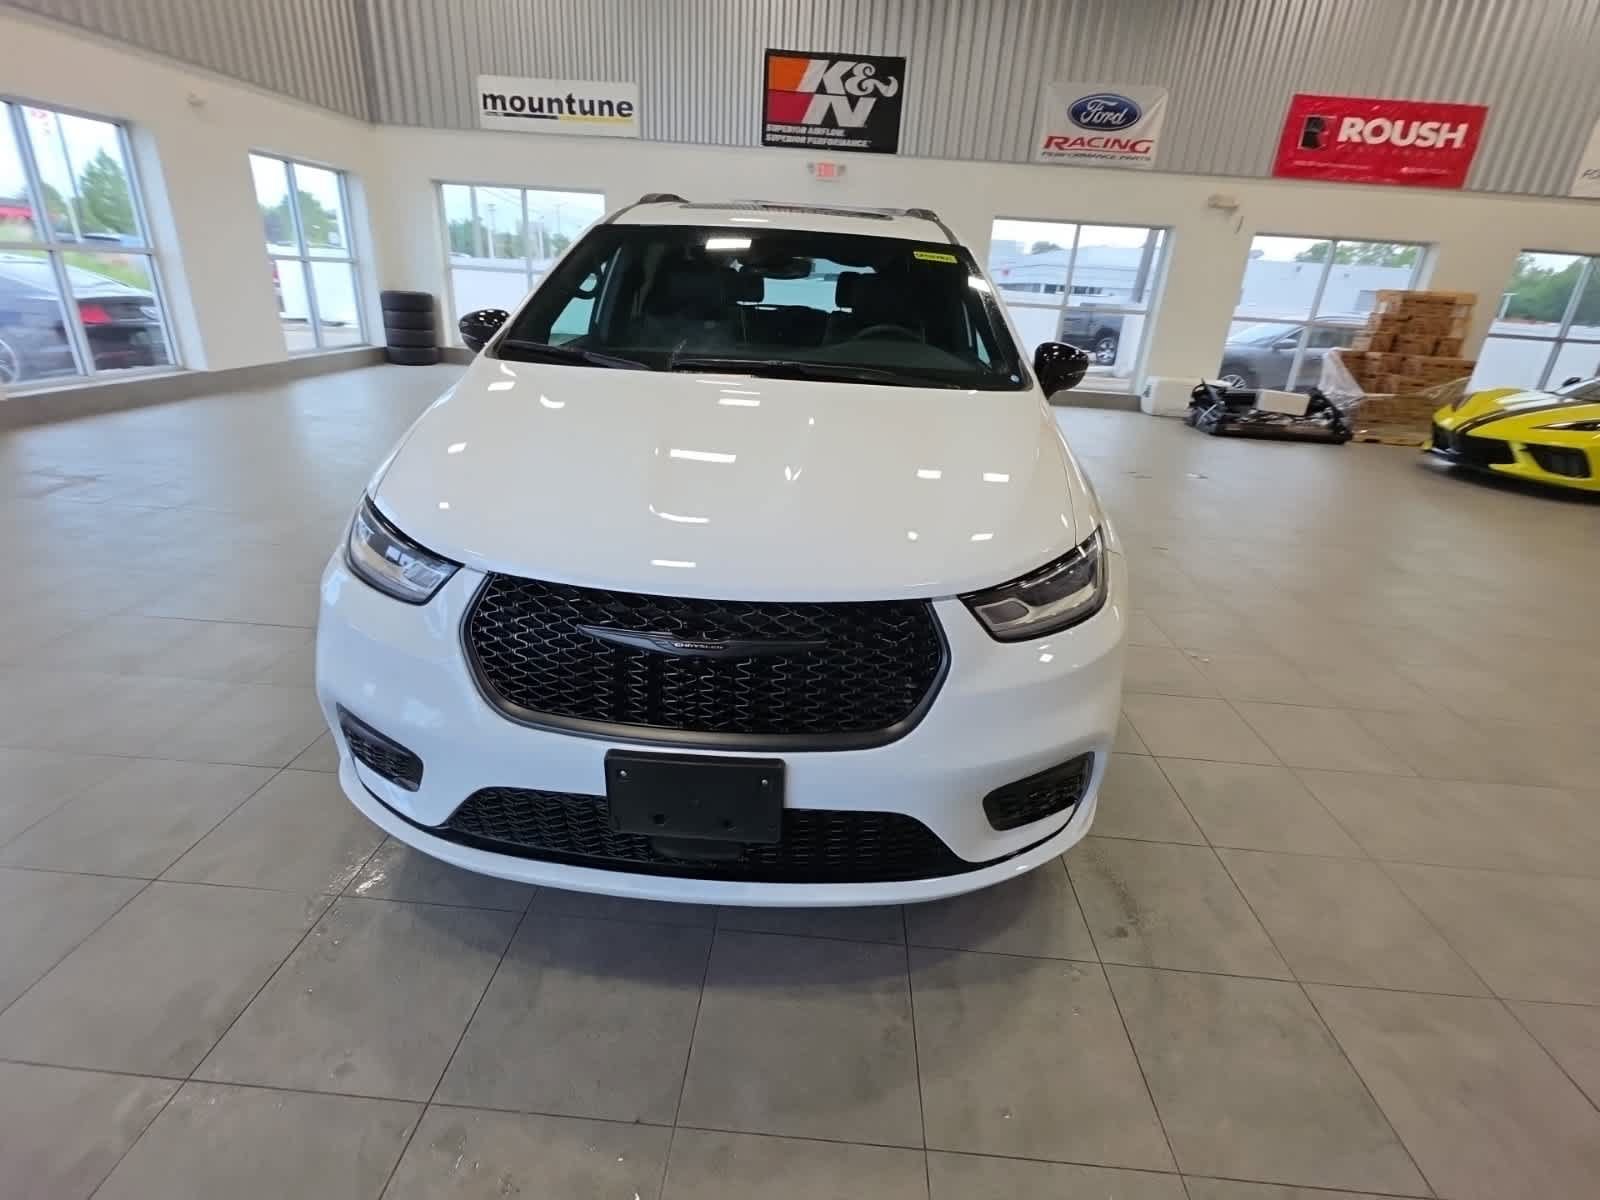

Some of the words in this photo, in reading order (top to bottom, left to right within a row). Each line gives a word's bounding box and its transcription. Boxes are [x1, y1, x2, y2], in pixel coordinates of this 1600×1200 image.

[482, 92, 634, 118] mountune
[1080, 99, 1130, 125] Ford
[1044, 135, 1155, 154] RACING
[1337, 116, 1469, 149] ROUSH
